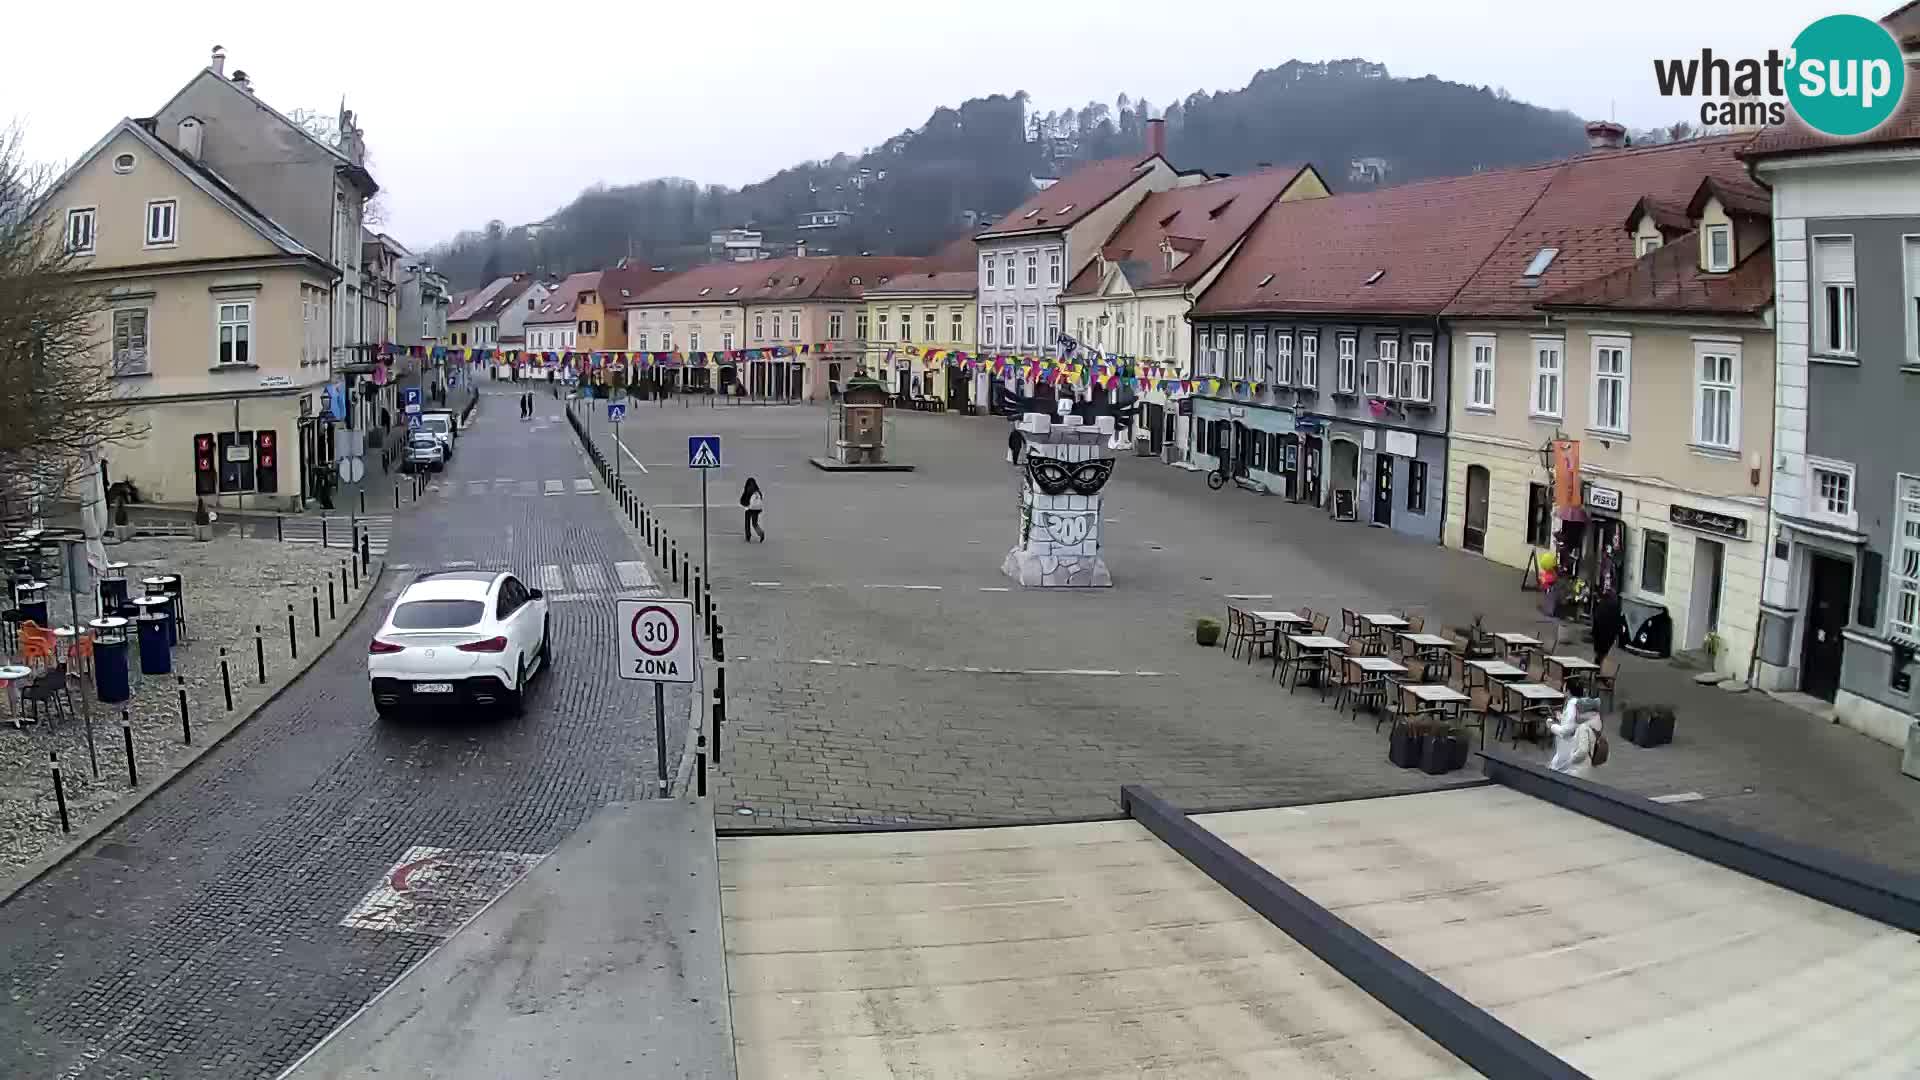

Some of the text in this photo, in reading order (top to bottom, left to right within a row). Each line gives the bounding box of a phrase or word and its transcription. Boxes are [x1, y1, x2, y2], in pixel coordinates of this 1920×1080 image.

[409, 391, 416, 401] P
[1047, 515, 1087, 544] 200
[644, 621, 668, 642] 30
[634, 659, 678, 675] ZONA
